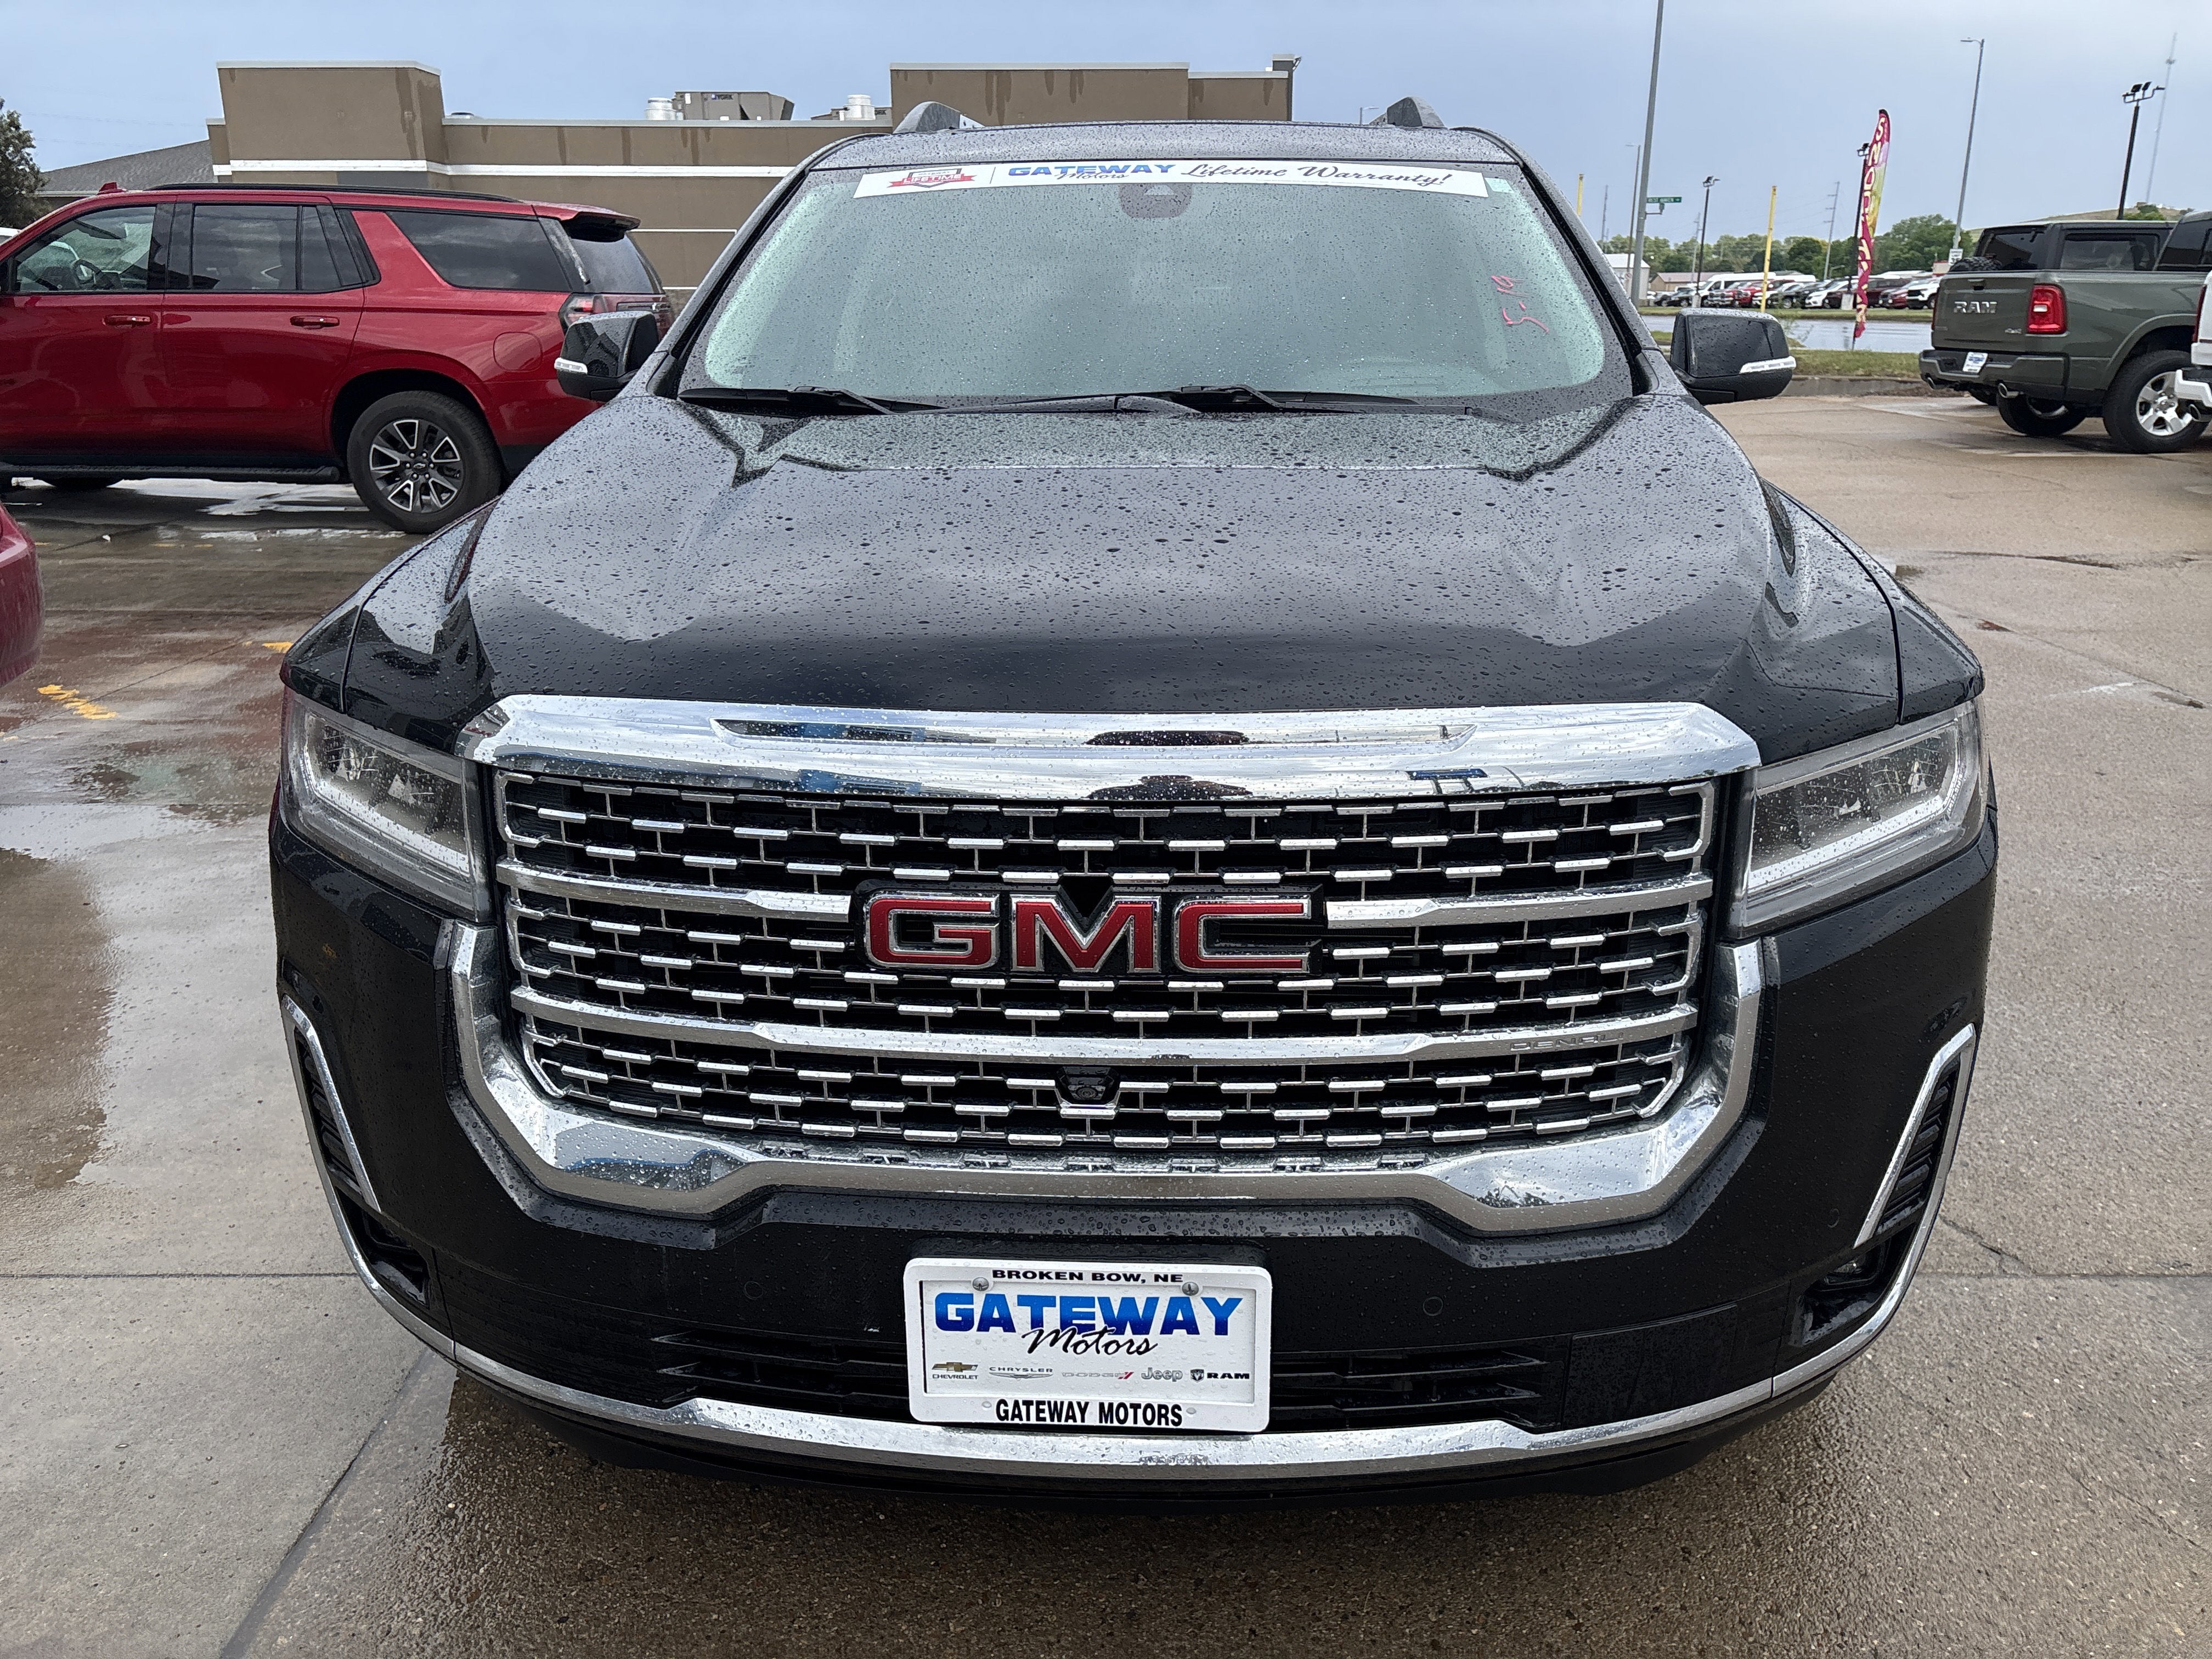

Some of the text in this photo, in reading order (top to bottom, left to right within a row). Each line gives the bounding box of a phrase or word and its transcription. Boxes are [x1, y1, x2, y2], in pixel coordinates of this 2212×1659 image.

[903, 173, 962, 185] LIFETIME
[1008, 165, 1176, 176] GATEWAY
[1181, 163, 1286, 177] Lifetime
[1297, 166, 1453, 186] Warranty!
[1054, 172, 1129, 180] Motors
[1953, 301, 1997, 314] RAM
[864, 891, 1312, 974] GMC
[992, 1269, 1183, 1284] BROKEN BOW, NE
[934, 1293, 1244, 1336] GATEWAY
[1021, 1326, 1159, 1356] Motors
[1141, 1367, 1183, 1382] Jeep
[996, 1398, 1183, 1427] GATEWAY MOTORS
